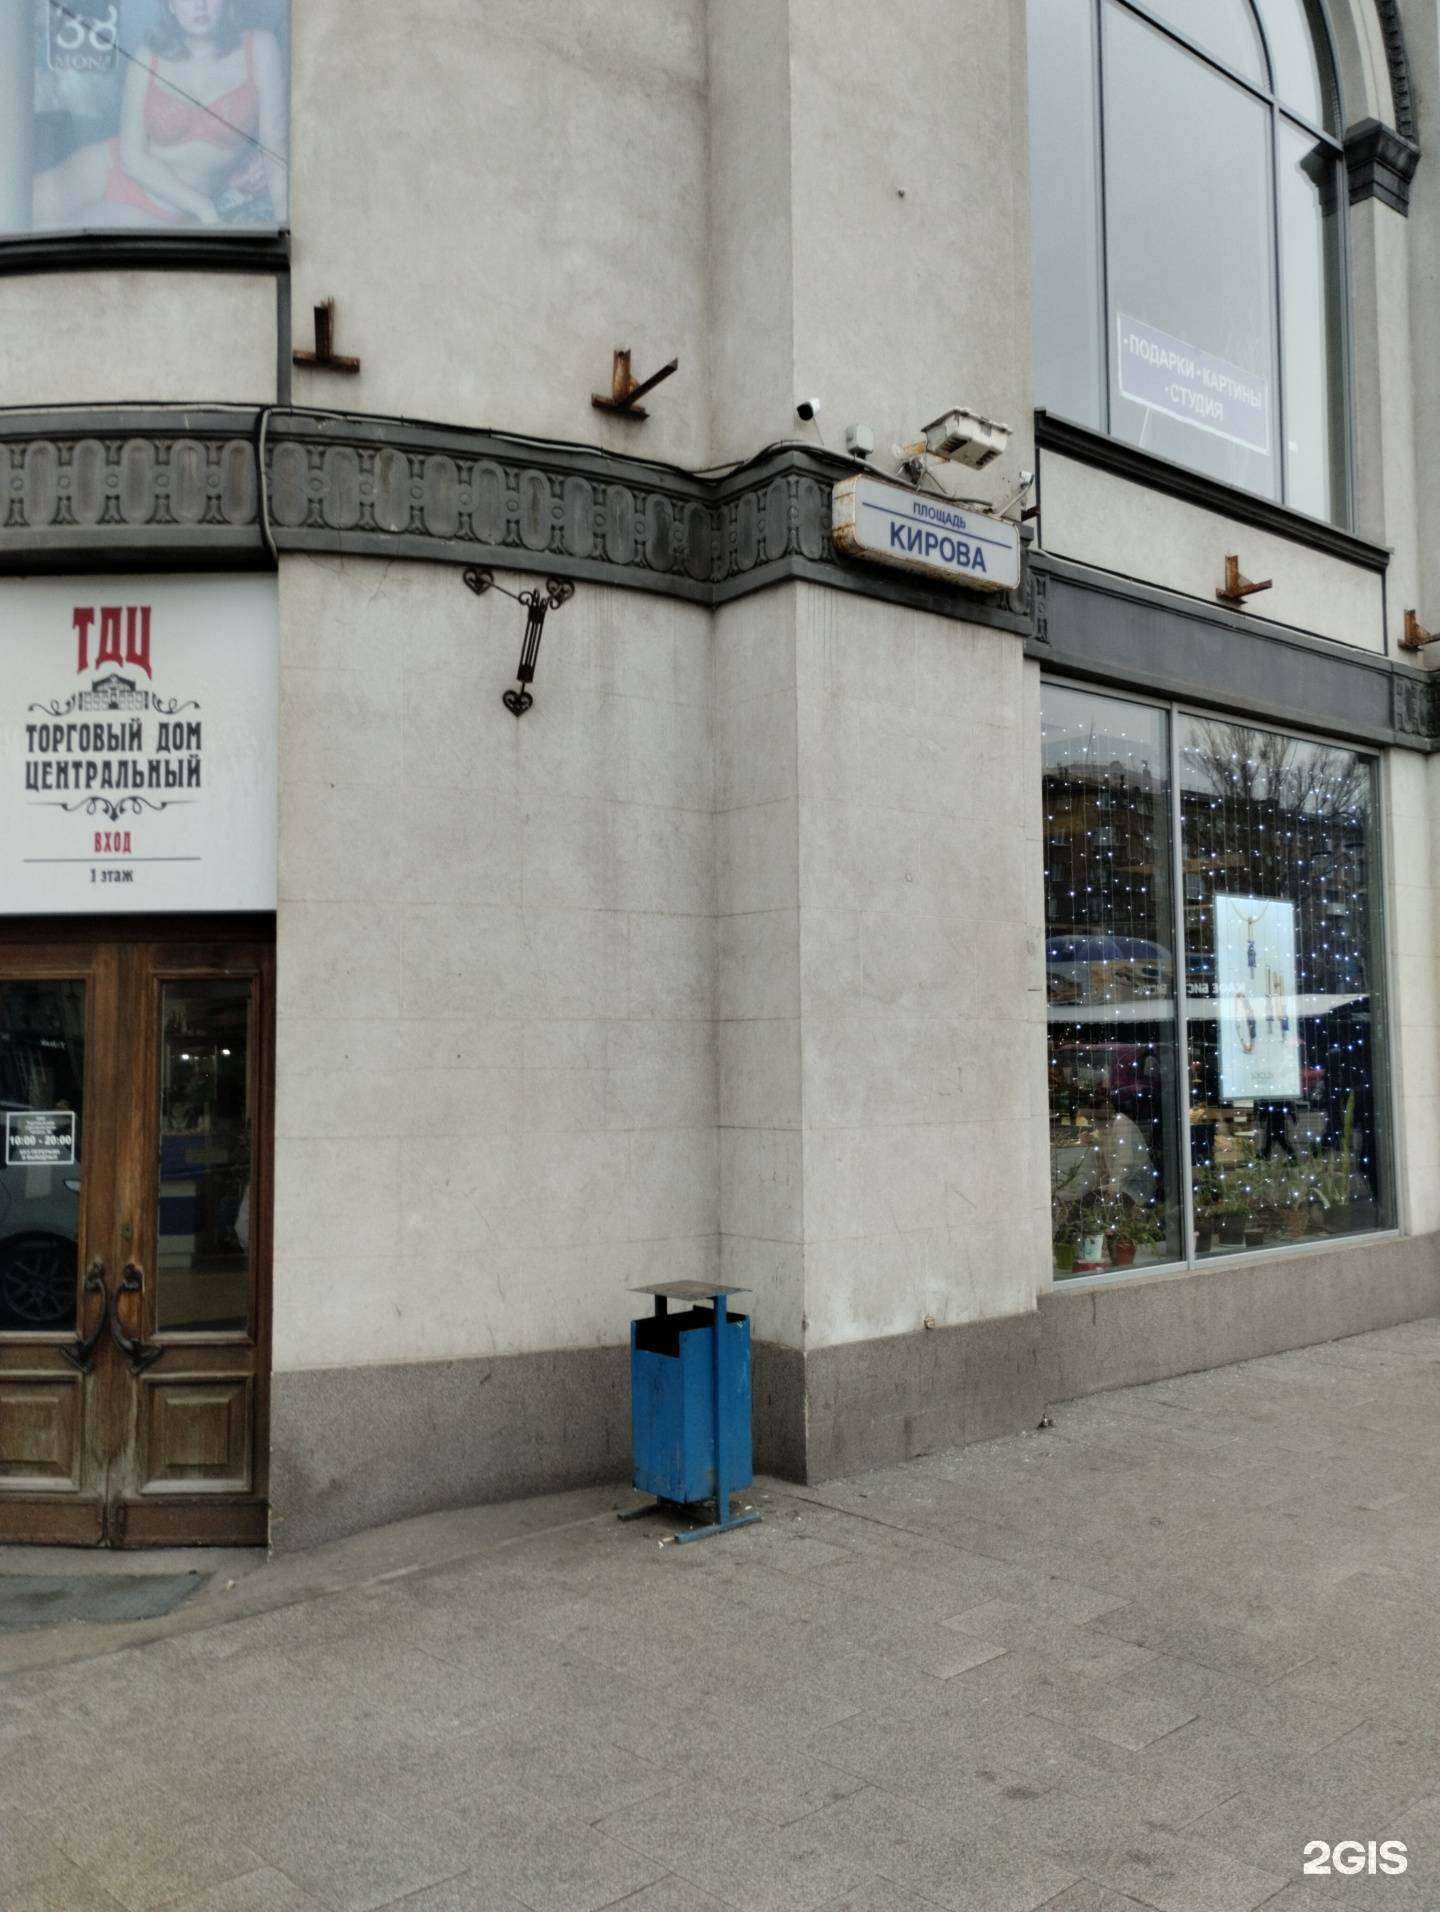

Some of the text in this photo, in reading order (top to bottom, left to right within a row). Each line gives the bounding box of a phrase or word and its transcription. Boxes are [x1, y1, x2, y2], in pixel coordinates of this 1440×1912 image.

[912, 502, 967, 529] ПЛОЩАДЬ
[889, 521, 987, 573] КИРОВА
[72, 604, 153, 681] ТДЦ
[25, 718, 202, 753] ТОРГОВЫЙ ДОМ
[25, 754, 202, 793] ЦЕНТРАЛЬНЫЙ
[94, 831, 132, 854] ВХОД
[90, 868, 134, 884] 1 этаж
[9, 1134, 36, 1146] 10:00
[44, 1134, 72, 1146] 20:00
